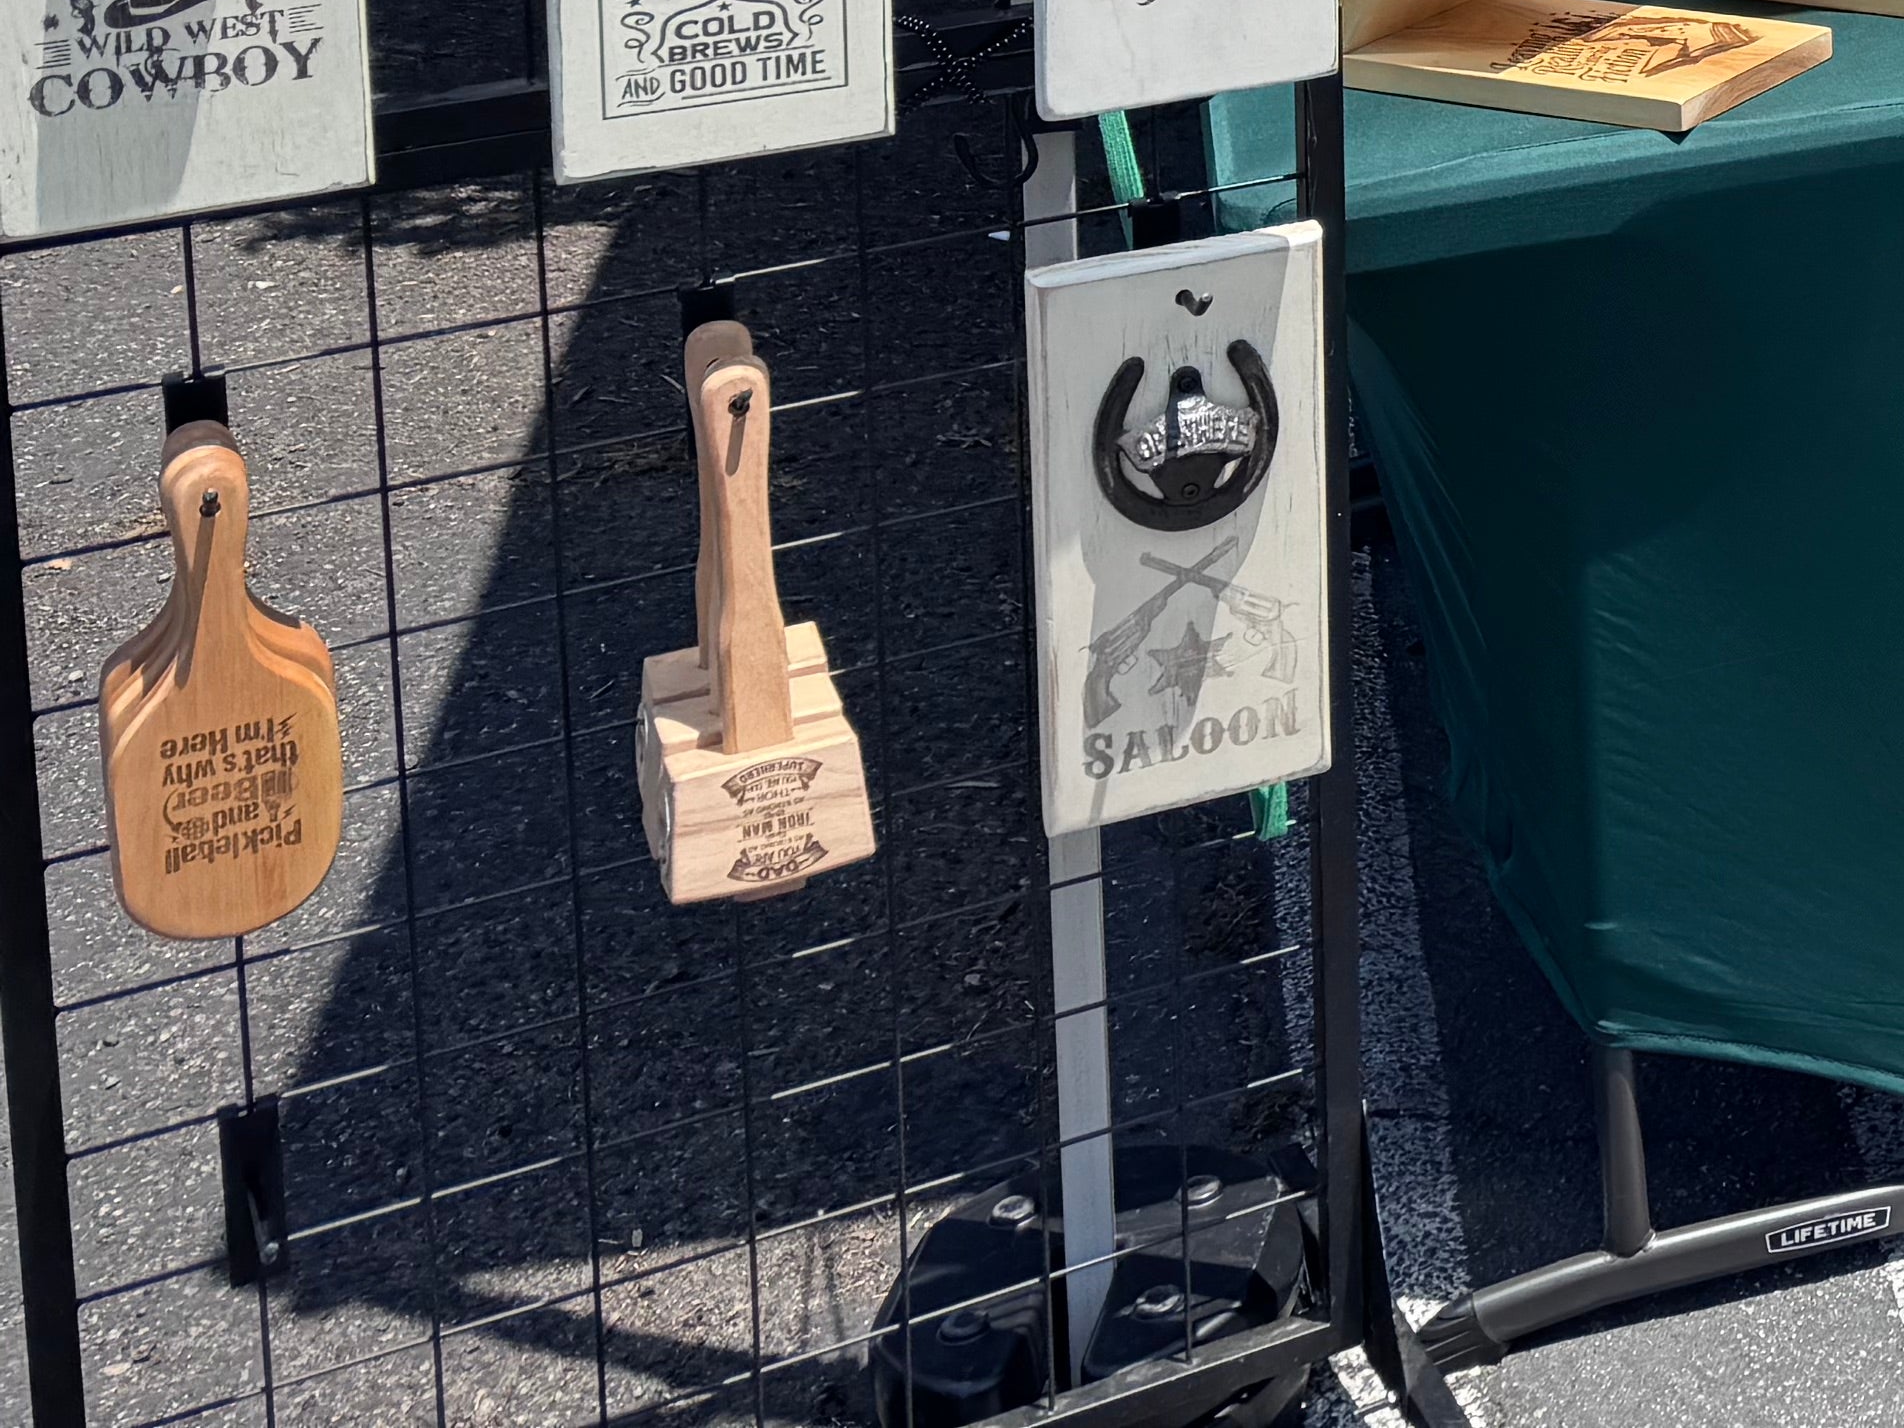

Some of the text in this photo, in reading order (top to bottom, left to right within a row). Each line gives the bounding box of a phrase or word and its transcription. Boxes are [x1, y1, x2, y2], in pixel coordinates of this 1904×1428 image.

[75, 8, 285, 66] WILD WEST
[674, 9, 776, 41] COLD
[667, 33, 785, 63] BREWS
[28, 37, 322, 117] COWBOY
[669, 60, 748, 94] GOOD
[757, 50, 827, 82] TIME
[160, 717, 275, 760] I'm Here
[1082, 688, 1300, 781] SALOON
[162, 740, 299, 789] that's why
[171, 775, 259, 812] Beer
[212, 802, 260, 836] and
[742, 820, 773, 839] MAN
[165, 818, 302, 875] Pickleball
[1778, 1213, 1877, 1247] LIFETIME
